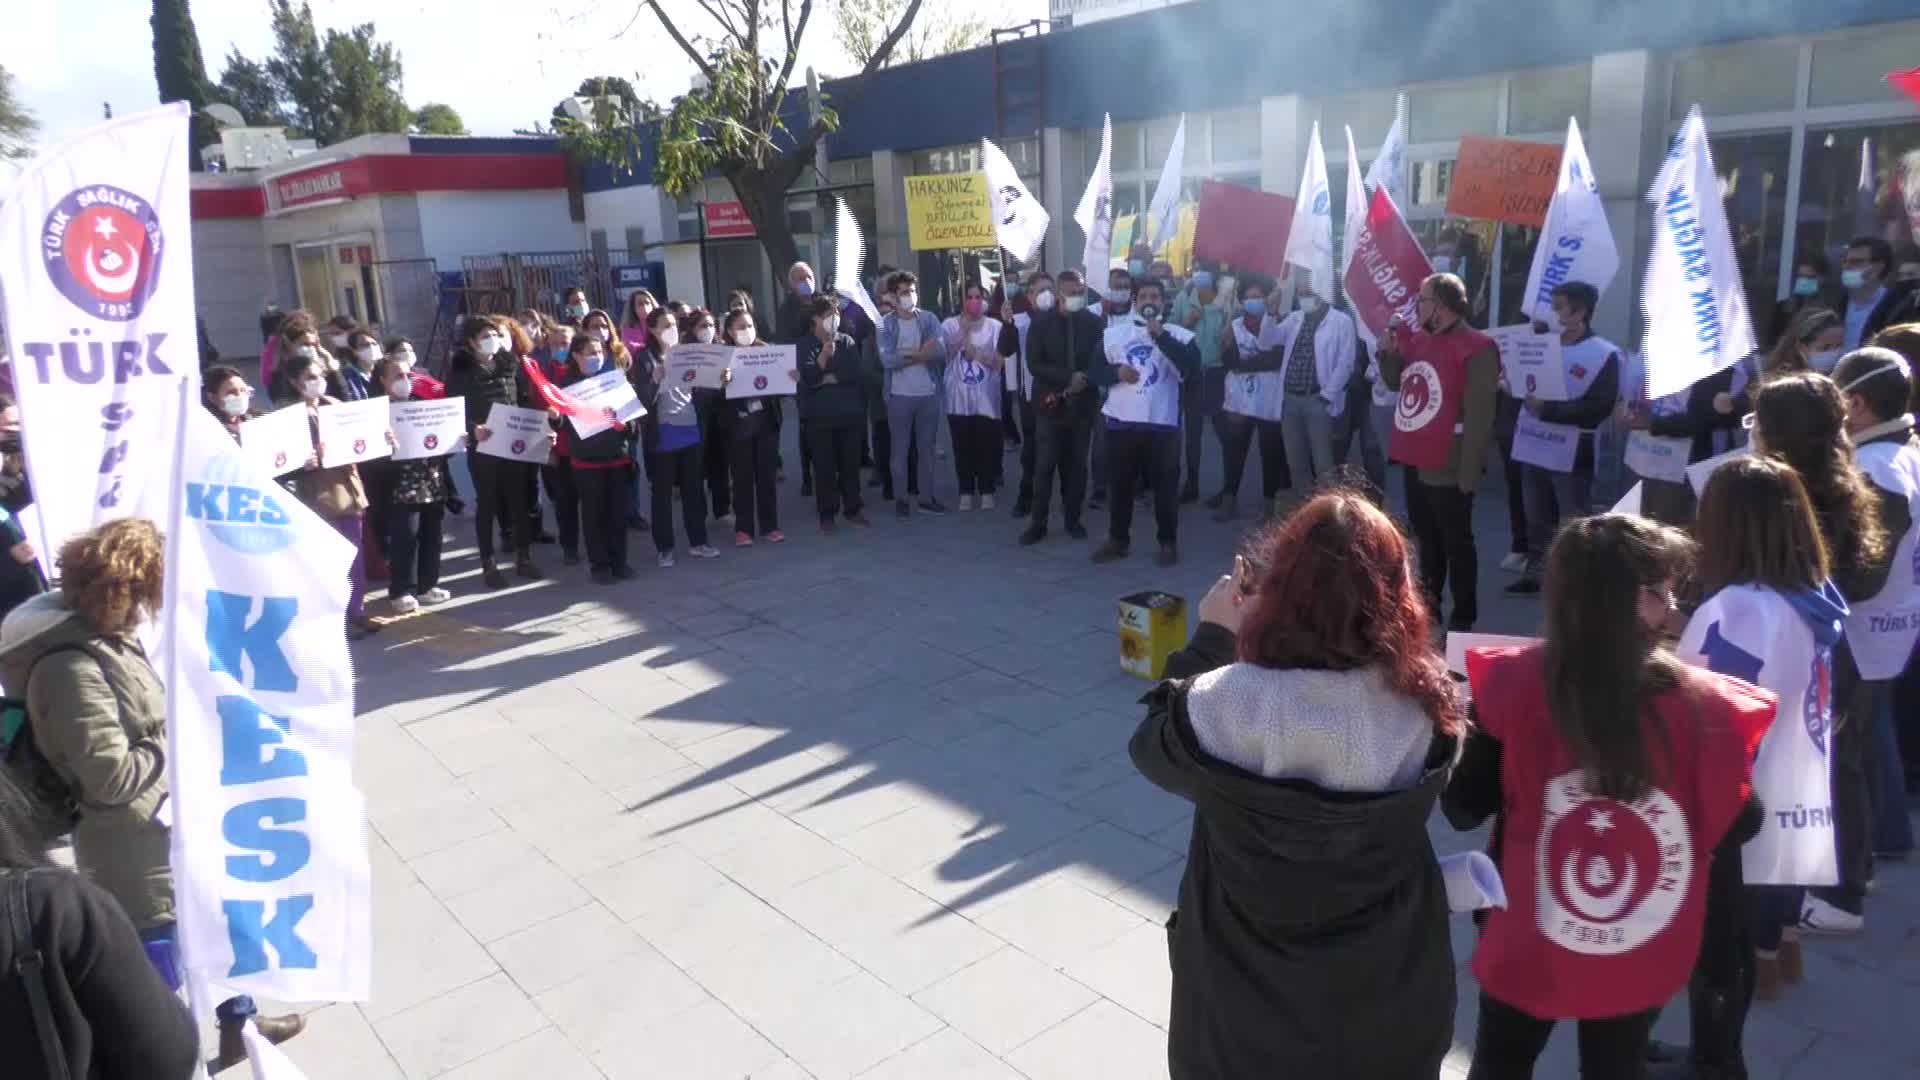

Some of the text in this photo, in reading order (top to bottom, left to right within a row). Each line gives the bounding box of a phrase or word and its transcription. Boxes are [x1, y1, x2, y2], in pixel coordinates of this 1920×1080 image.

[76, 187, 143, 214] SAĞLIK
[908, 176, 974, 198] HAKKINIZ
[926, 223, 993, 241] ÖDEMEDİLE
[23, 328, 174, 385] TÜRK
[205, 589, 319, 978] KESK
